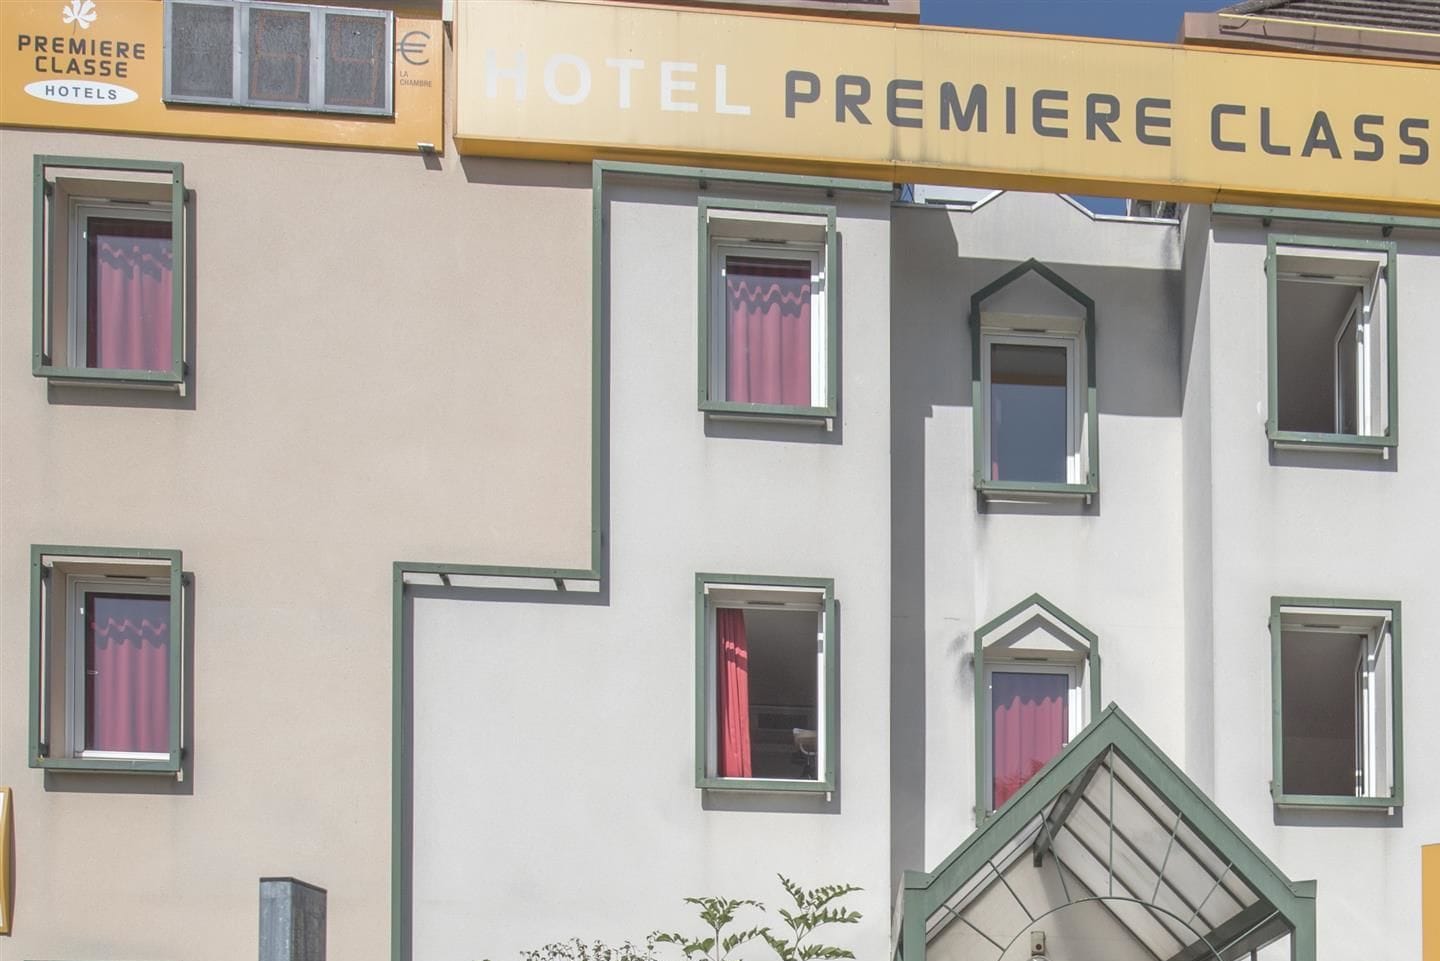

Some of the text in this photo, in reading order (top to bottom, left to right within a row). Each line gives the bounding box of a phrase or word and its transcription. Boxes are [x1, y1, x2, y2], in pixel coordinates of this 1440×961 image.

[18, 34, 146, 60] PREMIERE
[35, 56, 127, 78] CLASSE
[399, 70, 409, 78] LA
[45, 85, 118, 100] HOTELS
[399, 79, 433, 88] CHAMBRE
[484, 49, 751, 116] HOTEL
[785, 70, 1171, 147] PREMIERE
